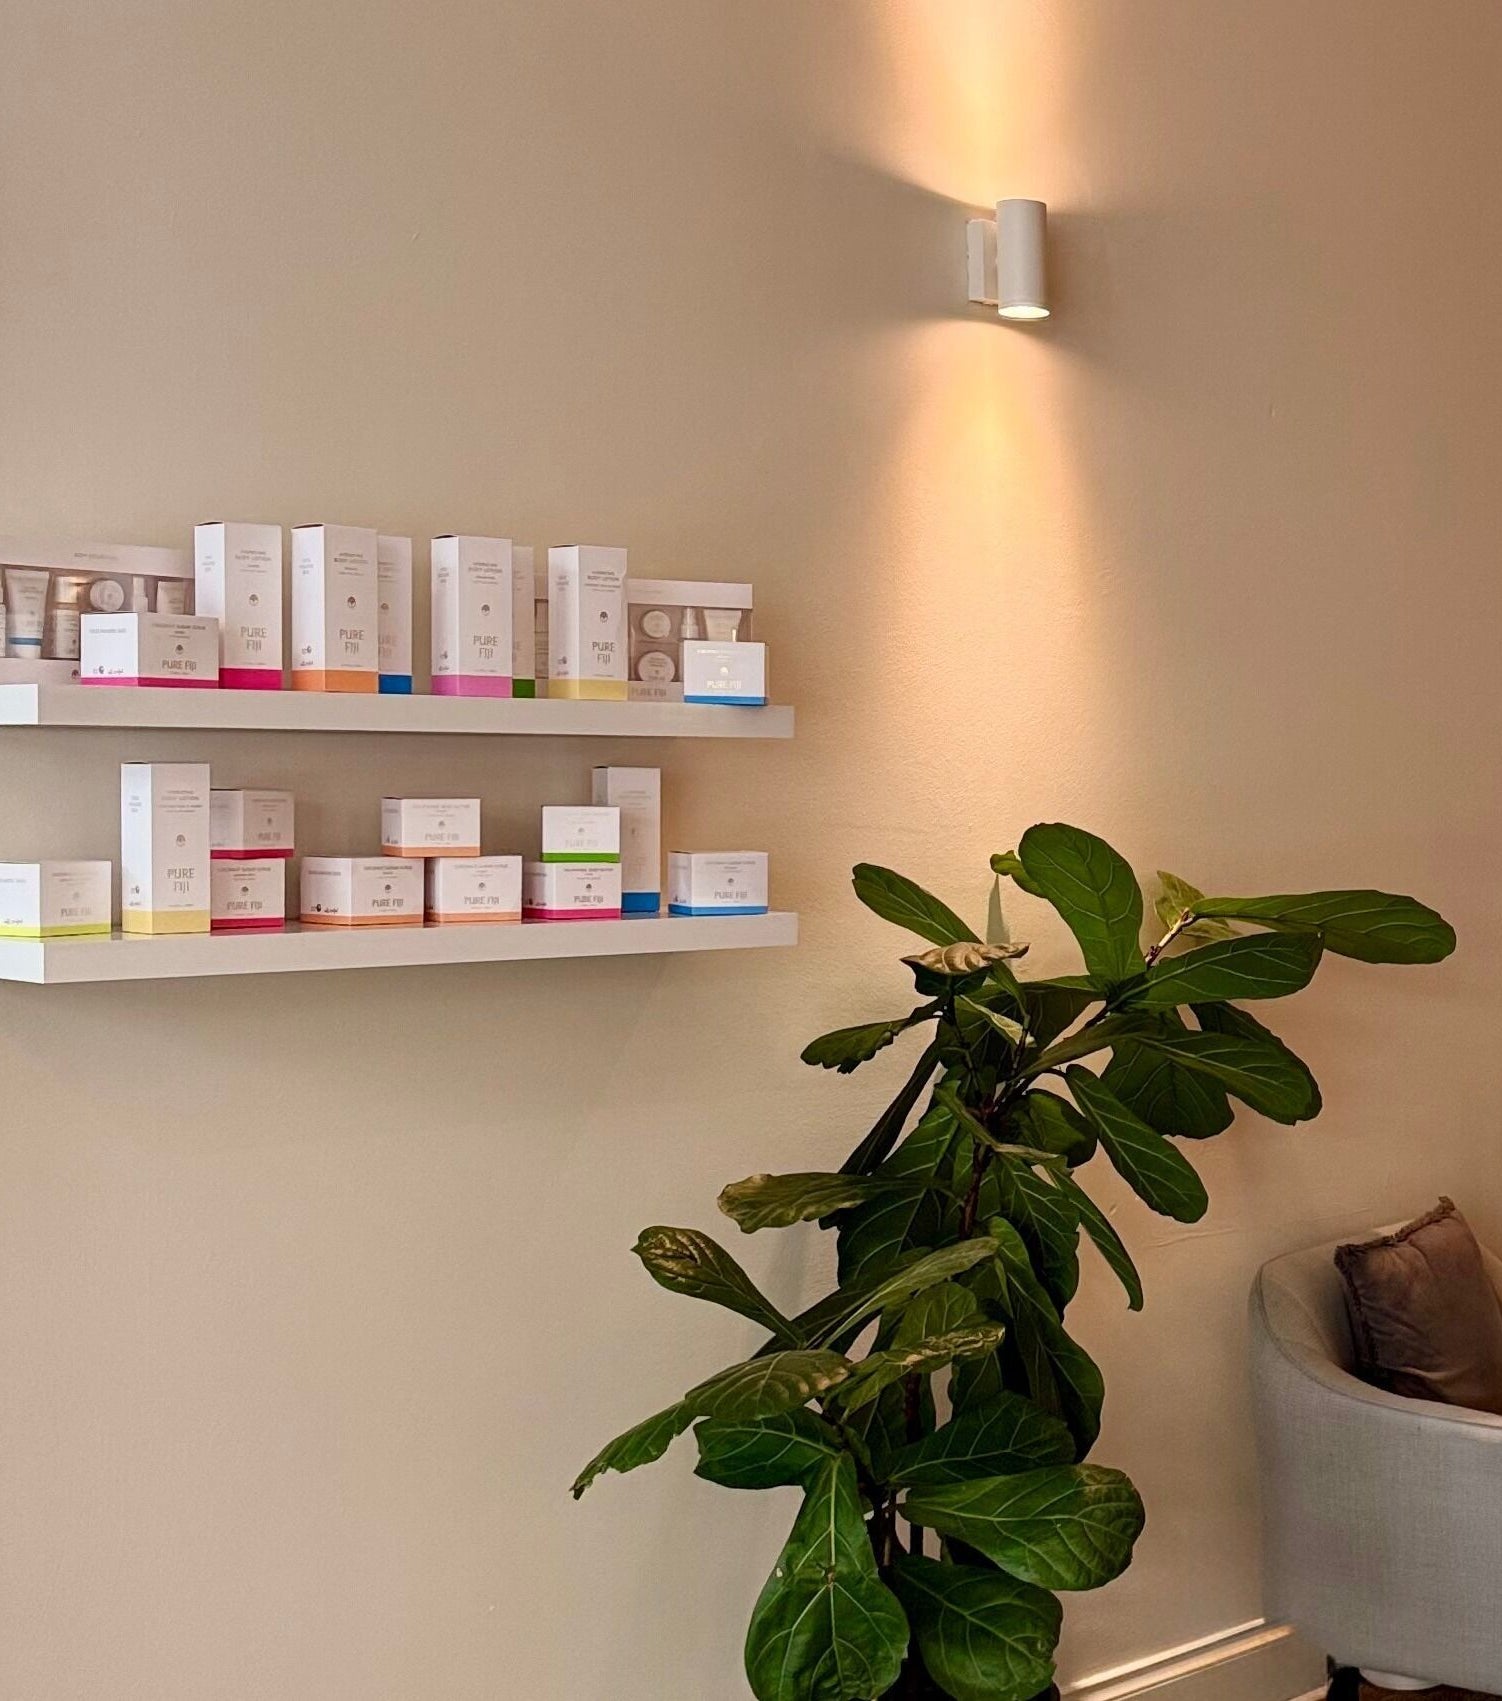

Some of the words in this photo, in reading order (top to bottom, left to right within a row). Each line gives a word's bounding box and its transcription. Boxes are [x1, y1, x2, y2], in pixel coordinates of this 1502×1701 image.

[240, 626, 267, 639] PURE
[339, 628, 364, 640] PURE
[473, 635, 499, 648] PURE
[592, 641, 615, 653] PURE
[162, 659, 183, 669] PURE
[167, 868, 195, 879] PURE
[227, 900, 249, 911] PURE
[372, 898, 391, 908] PURE
